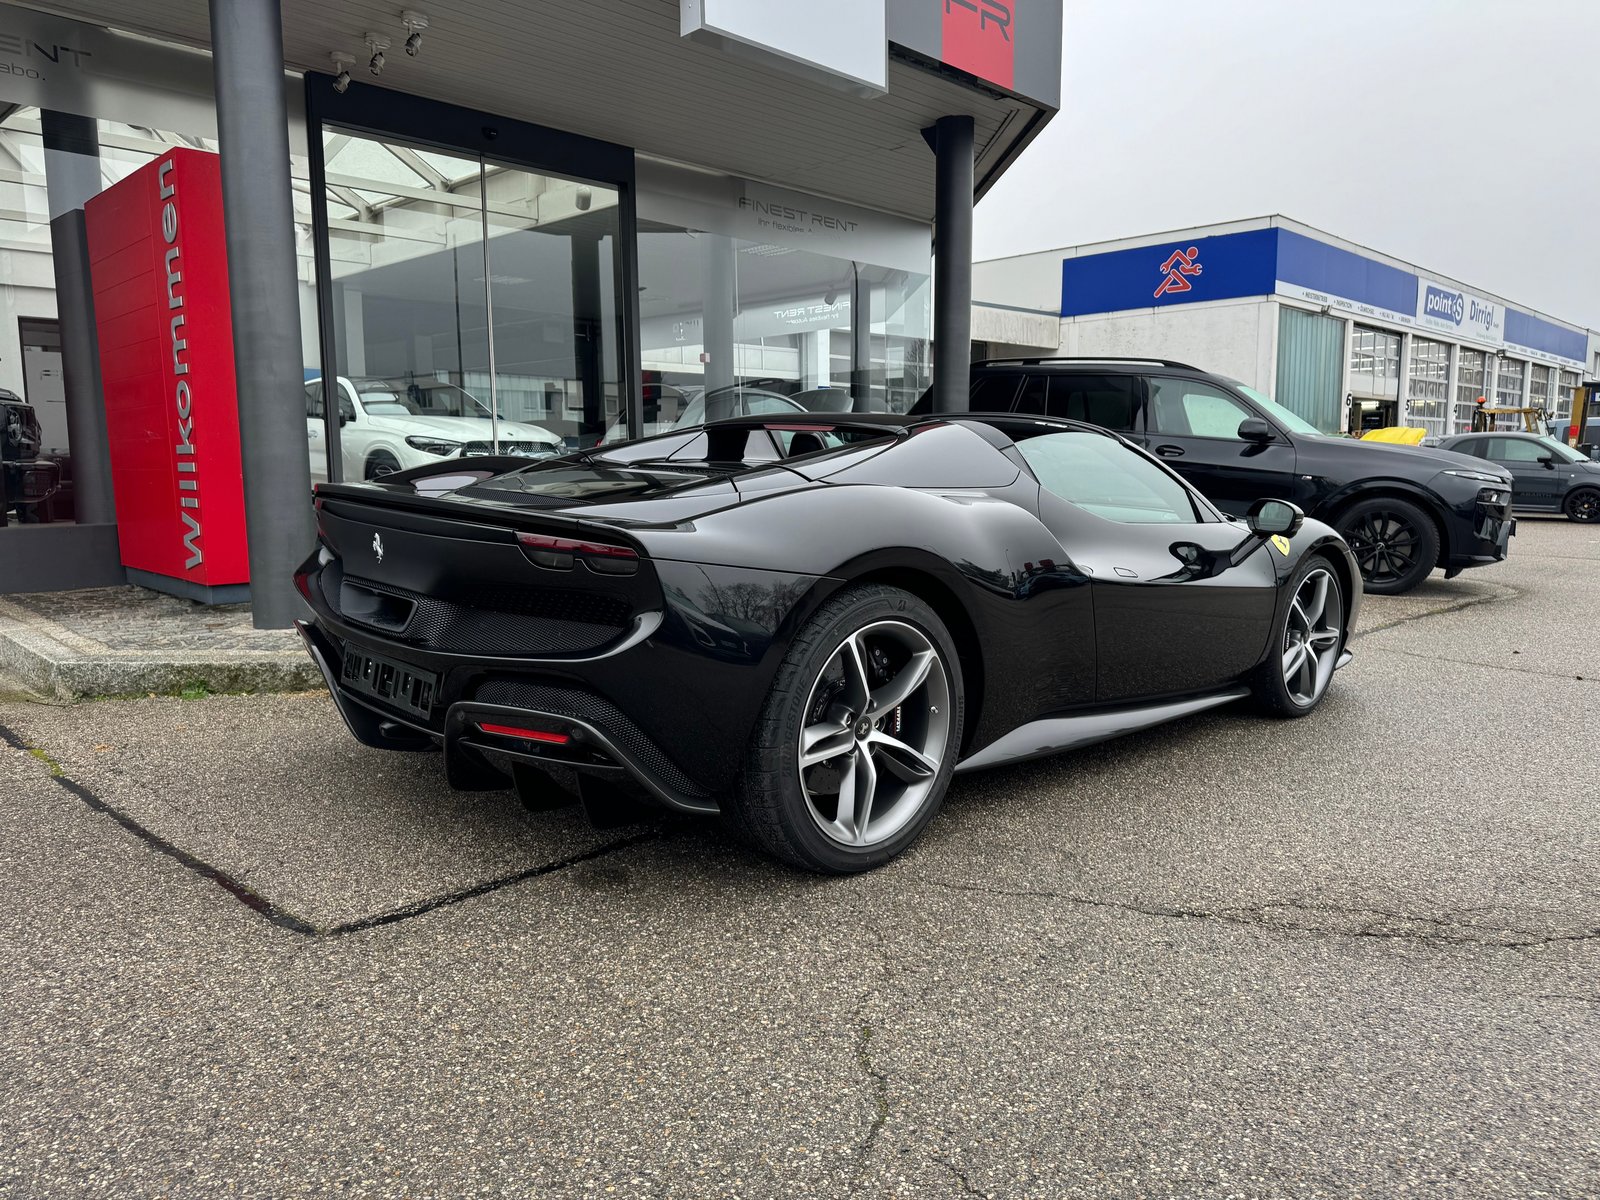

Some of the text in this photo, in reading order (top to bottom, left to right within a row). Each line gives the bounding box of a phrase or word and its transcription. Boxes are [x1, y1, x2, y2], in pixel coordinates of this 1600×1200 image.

[738, 196, 859, 232] FINEST RENT
[1427, 293, 1452, 314] point
[1470, 299, 1495, 331] Dirrigl
[1346, 393, 1352, 407] 6
[1405, 400, 1411, 411] 5
